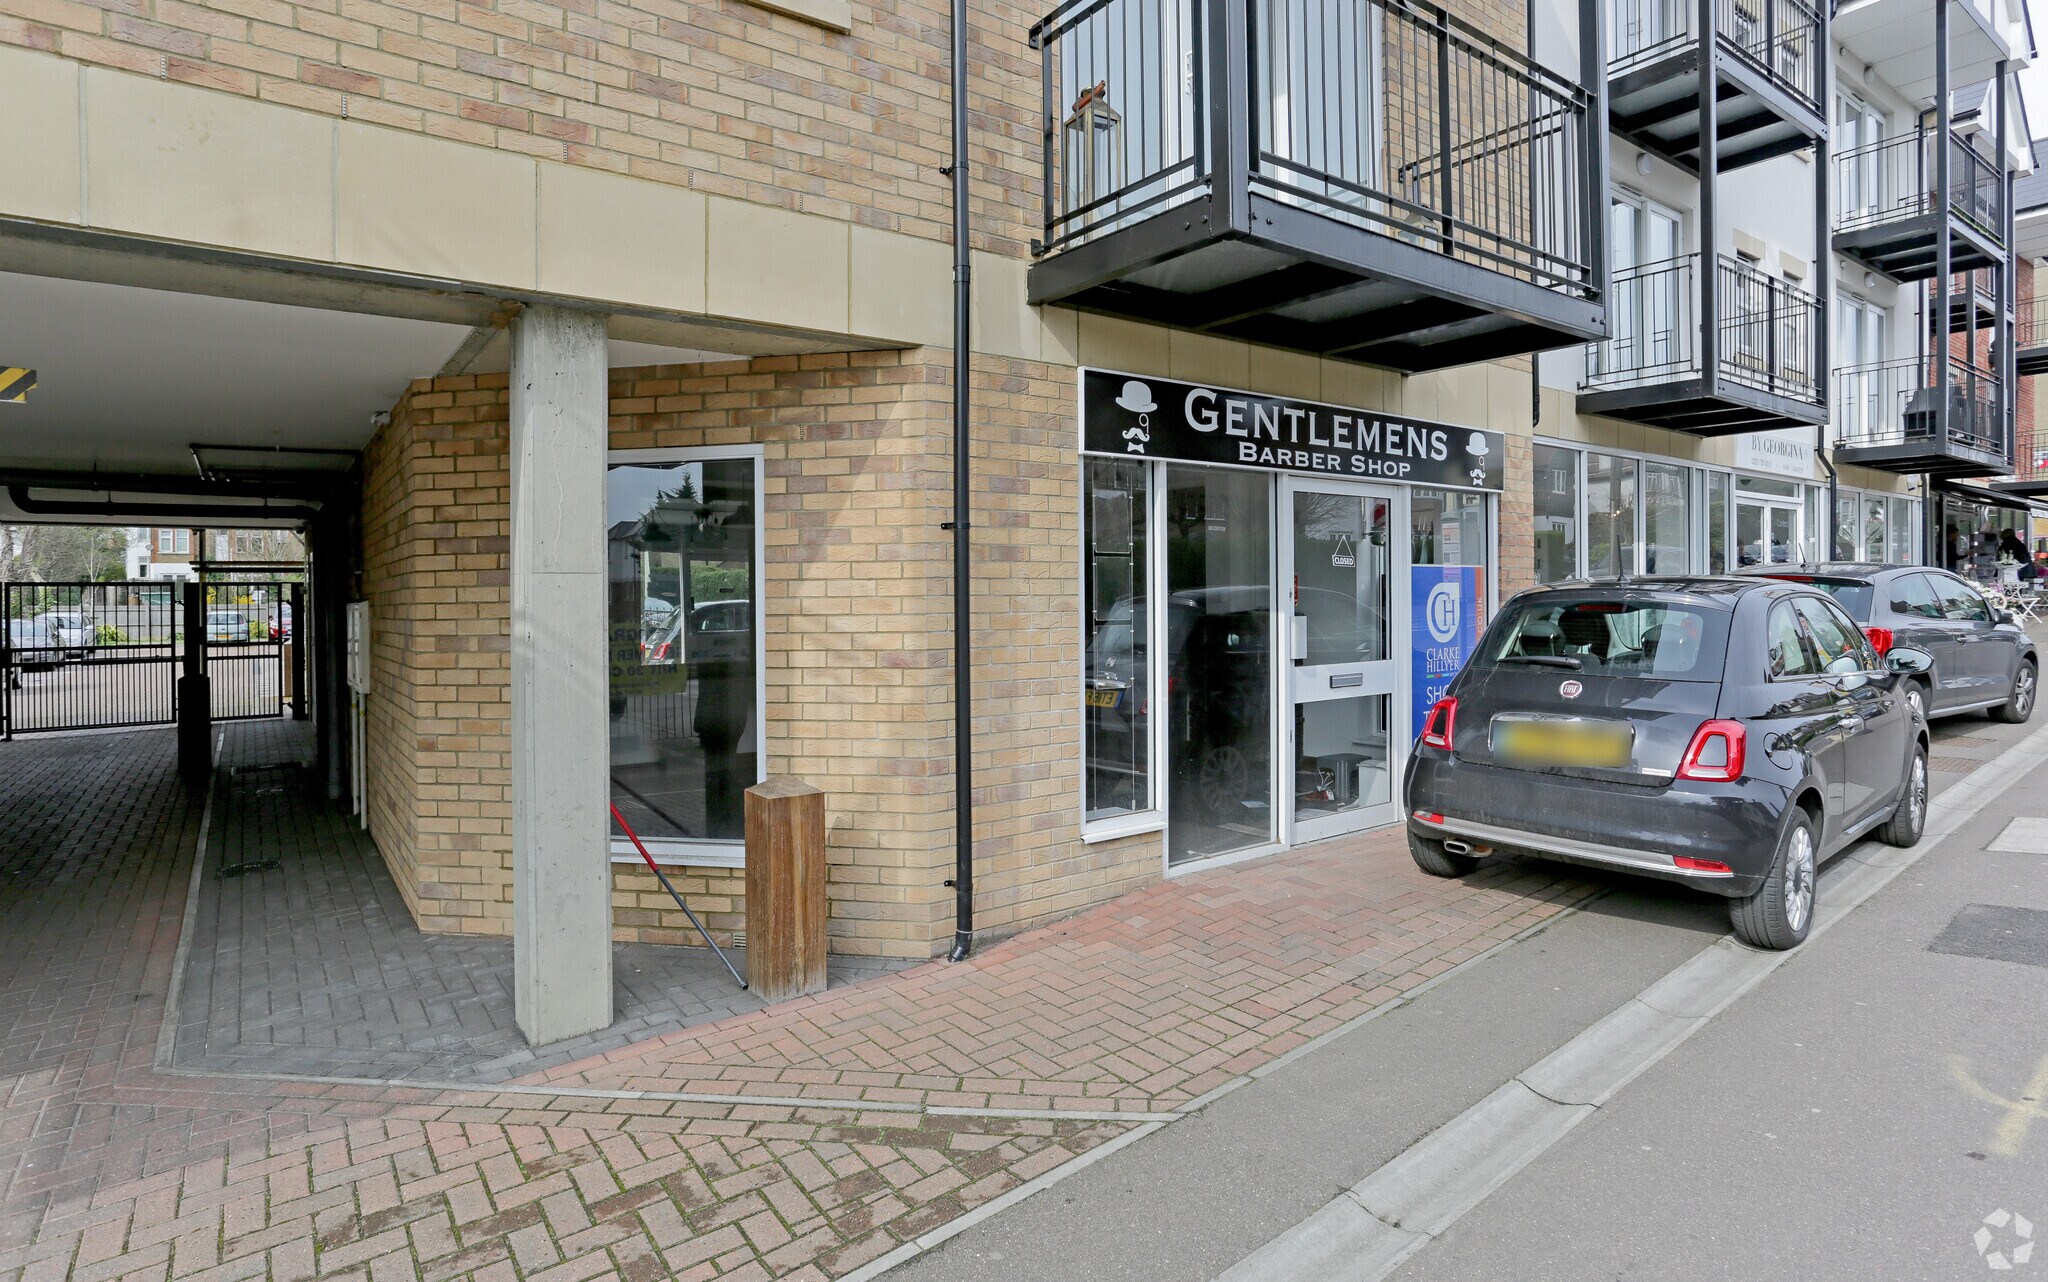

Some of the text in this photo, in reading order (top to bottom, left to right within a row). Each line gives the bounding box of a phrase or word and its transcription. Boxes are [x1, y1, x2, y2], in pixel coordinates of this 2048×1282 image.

[1184, 387, 1448, 461] GENTLEMENS
[1751, 434, 1804, 460] BY GEORGINA
[1238, 441, 1411, 477] BARBER SHOP
[1334, 557, 1354, 565] CLOSED
[1426, 647, 1460, 661] CLARKE
[1426, 660, 1460, 673] HILLYER
